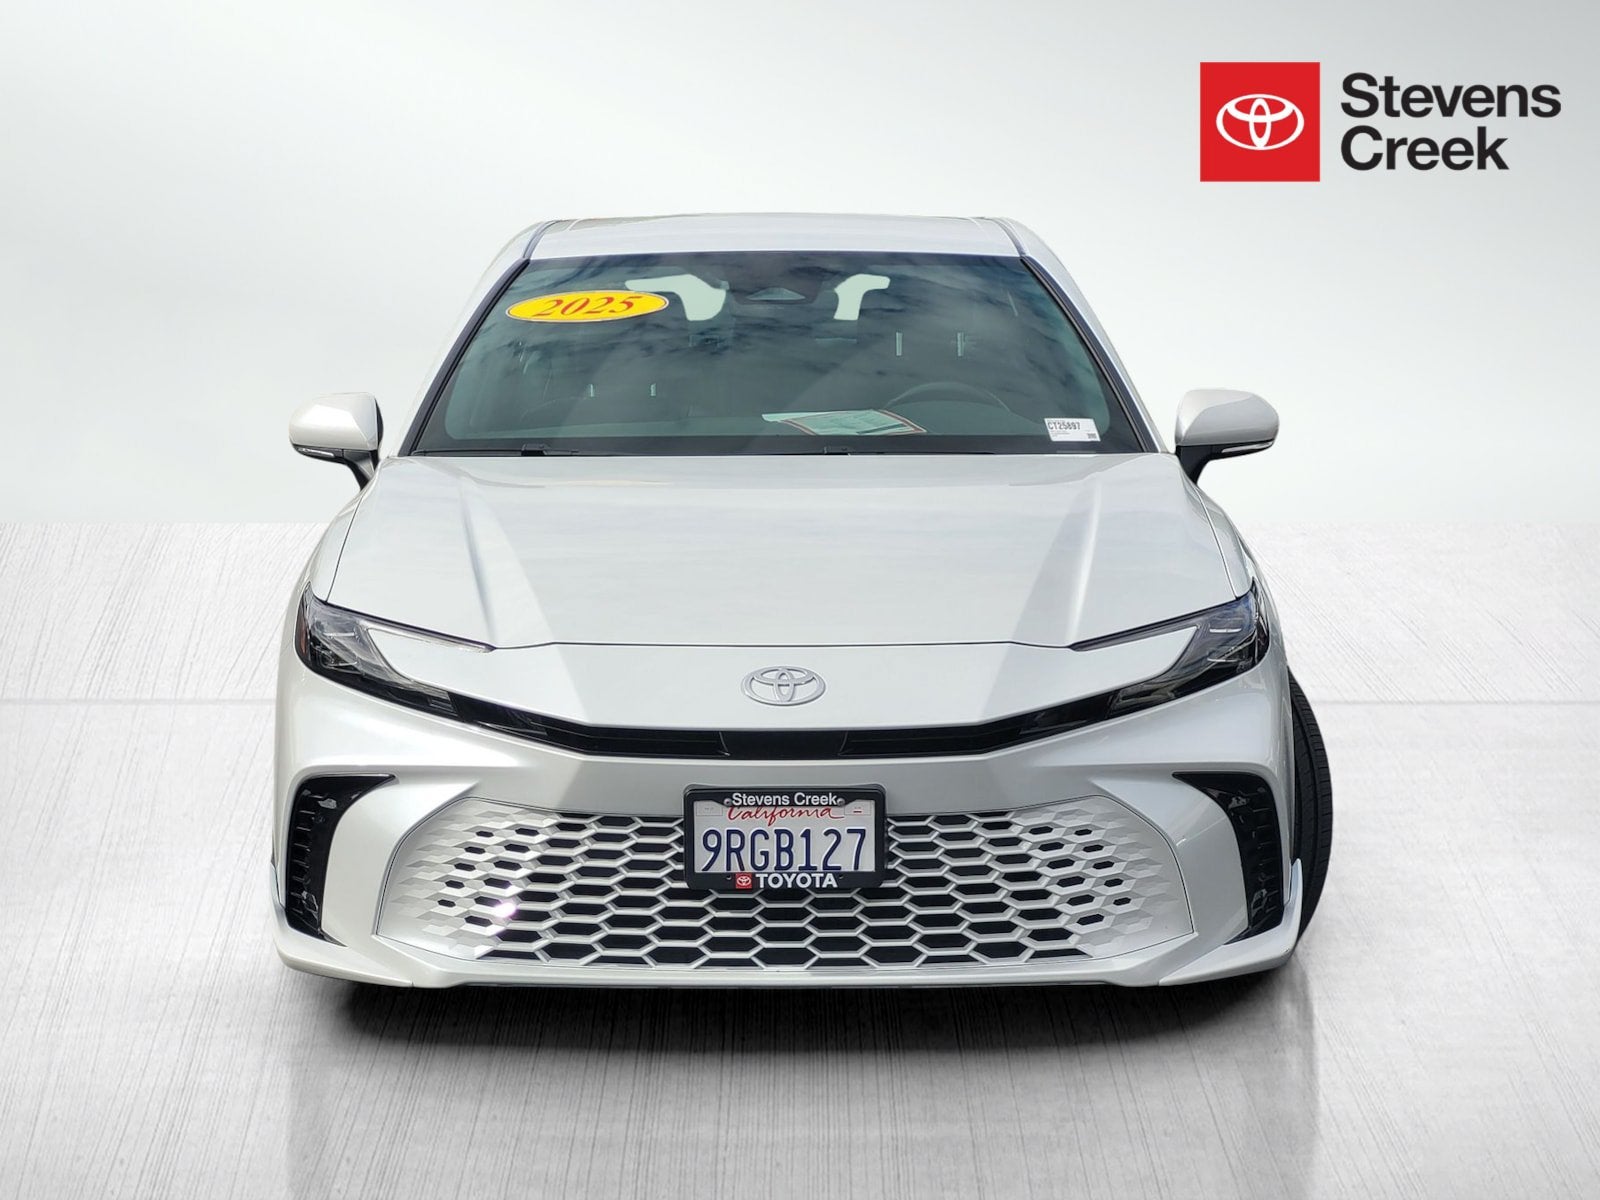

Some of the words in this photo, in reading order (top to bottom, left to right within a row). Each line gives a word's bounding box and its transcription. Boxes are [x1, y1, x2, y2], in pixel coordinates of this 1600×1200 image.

[532, 295, 643, 318] 2025
[732, 792, 790, 806] Stevens
[794, 792, 838, 806] Creek
[727, 805, 844, 827] California
[702, 828, 867, 871] 9RGB127
[755, 873, 838, 888] TOYOTA
